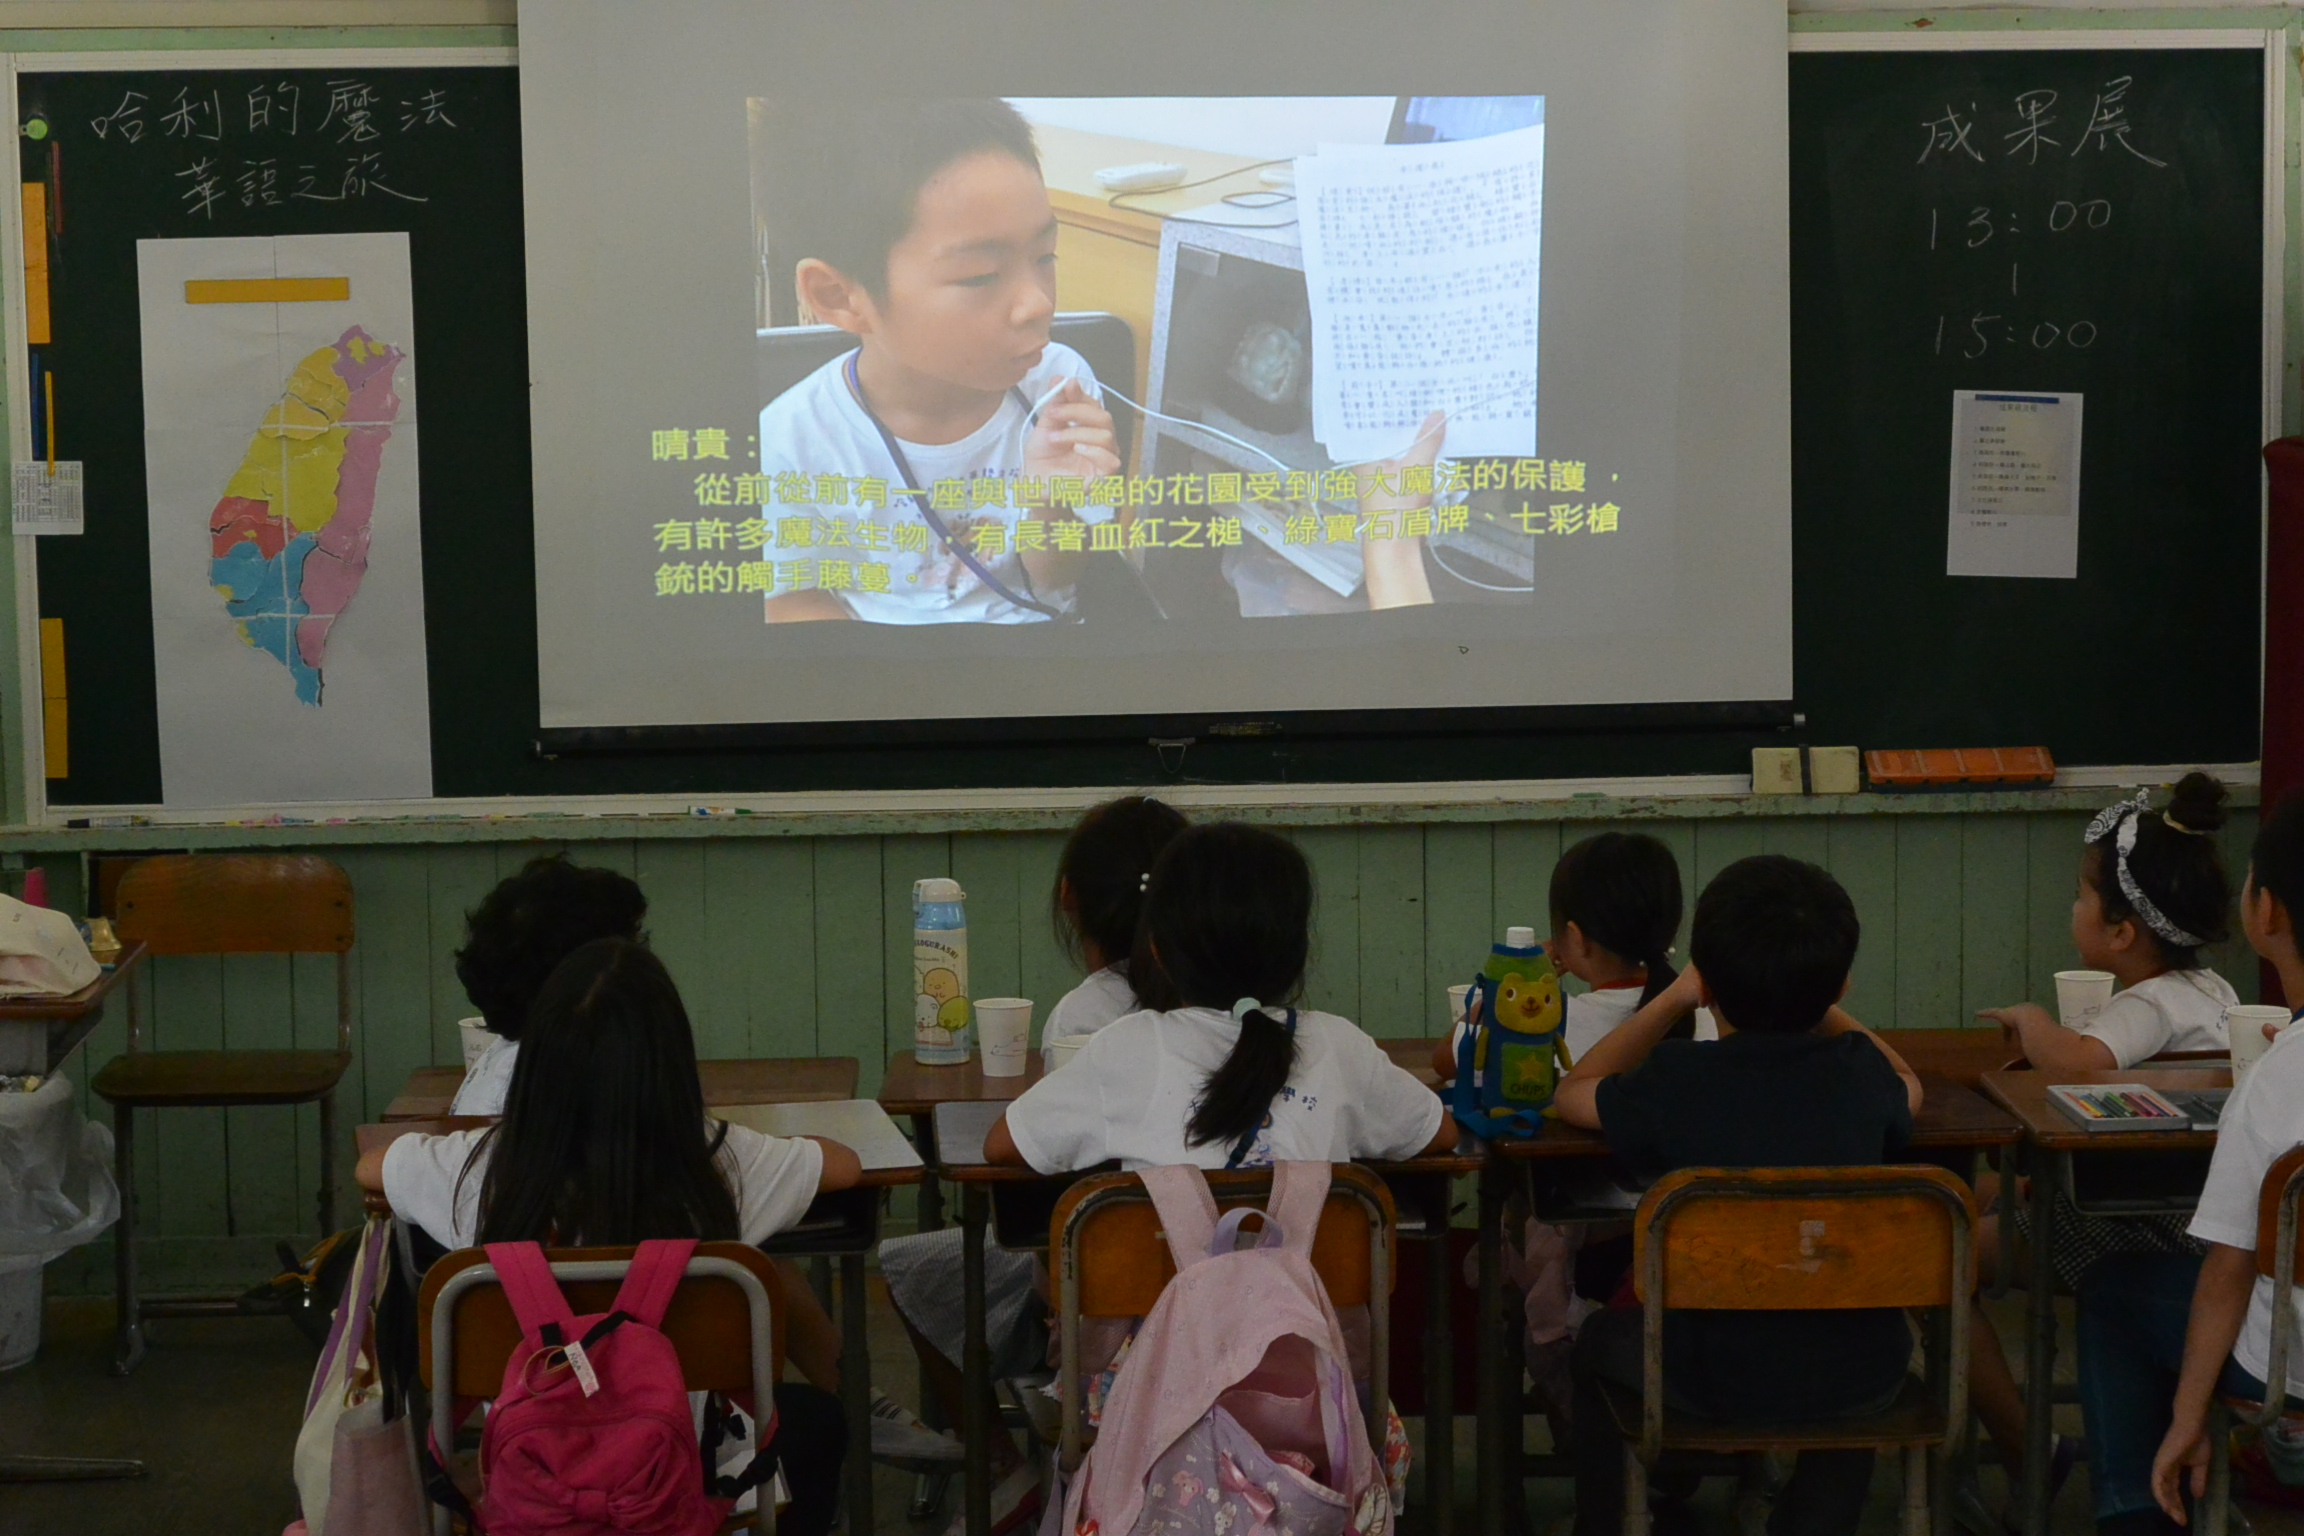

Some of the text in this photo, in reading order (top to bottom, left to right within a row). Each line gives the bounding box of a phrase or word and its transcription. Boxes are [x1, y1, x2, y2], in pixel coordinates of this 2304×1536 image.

[91, 79, 458, 144] 哈利的魔法
[1916, 75, 2168, 168] 成果展
[174, 151, 429, 220] 華語之旅
[1935, 311, 2098, 359] 15:00
